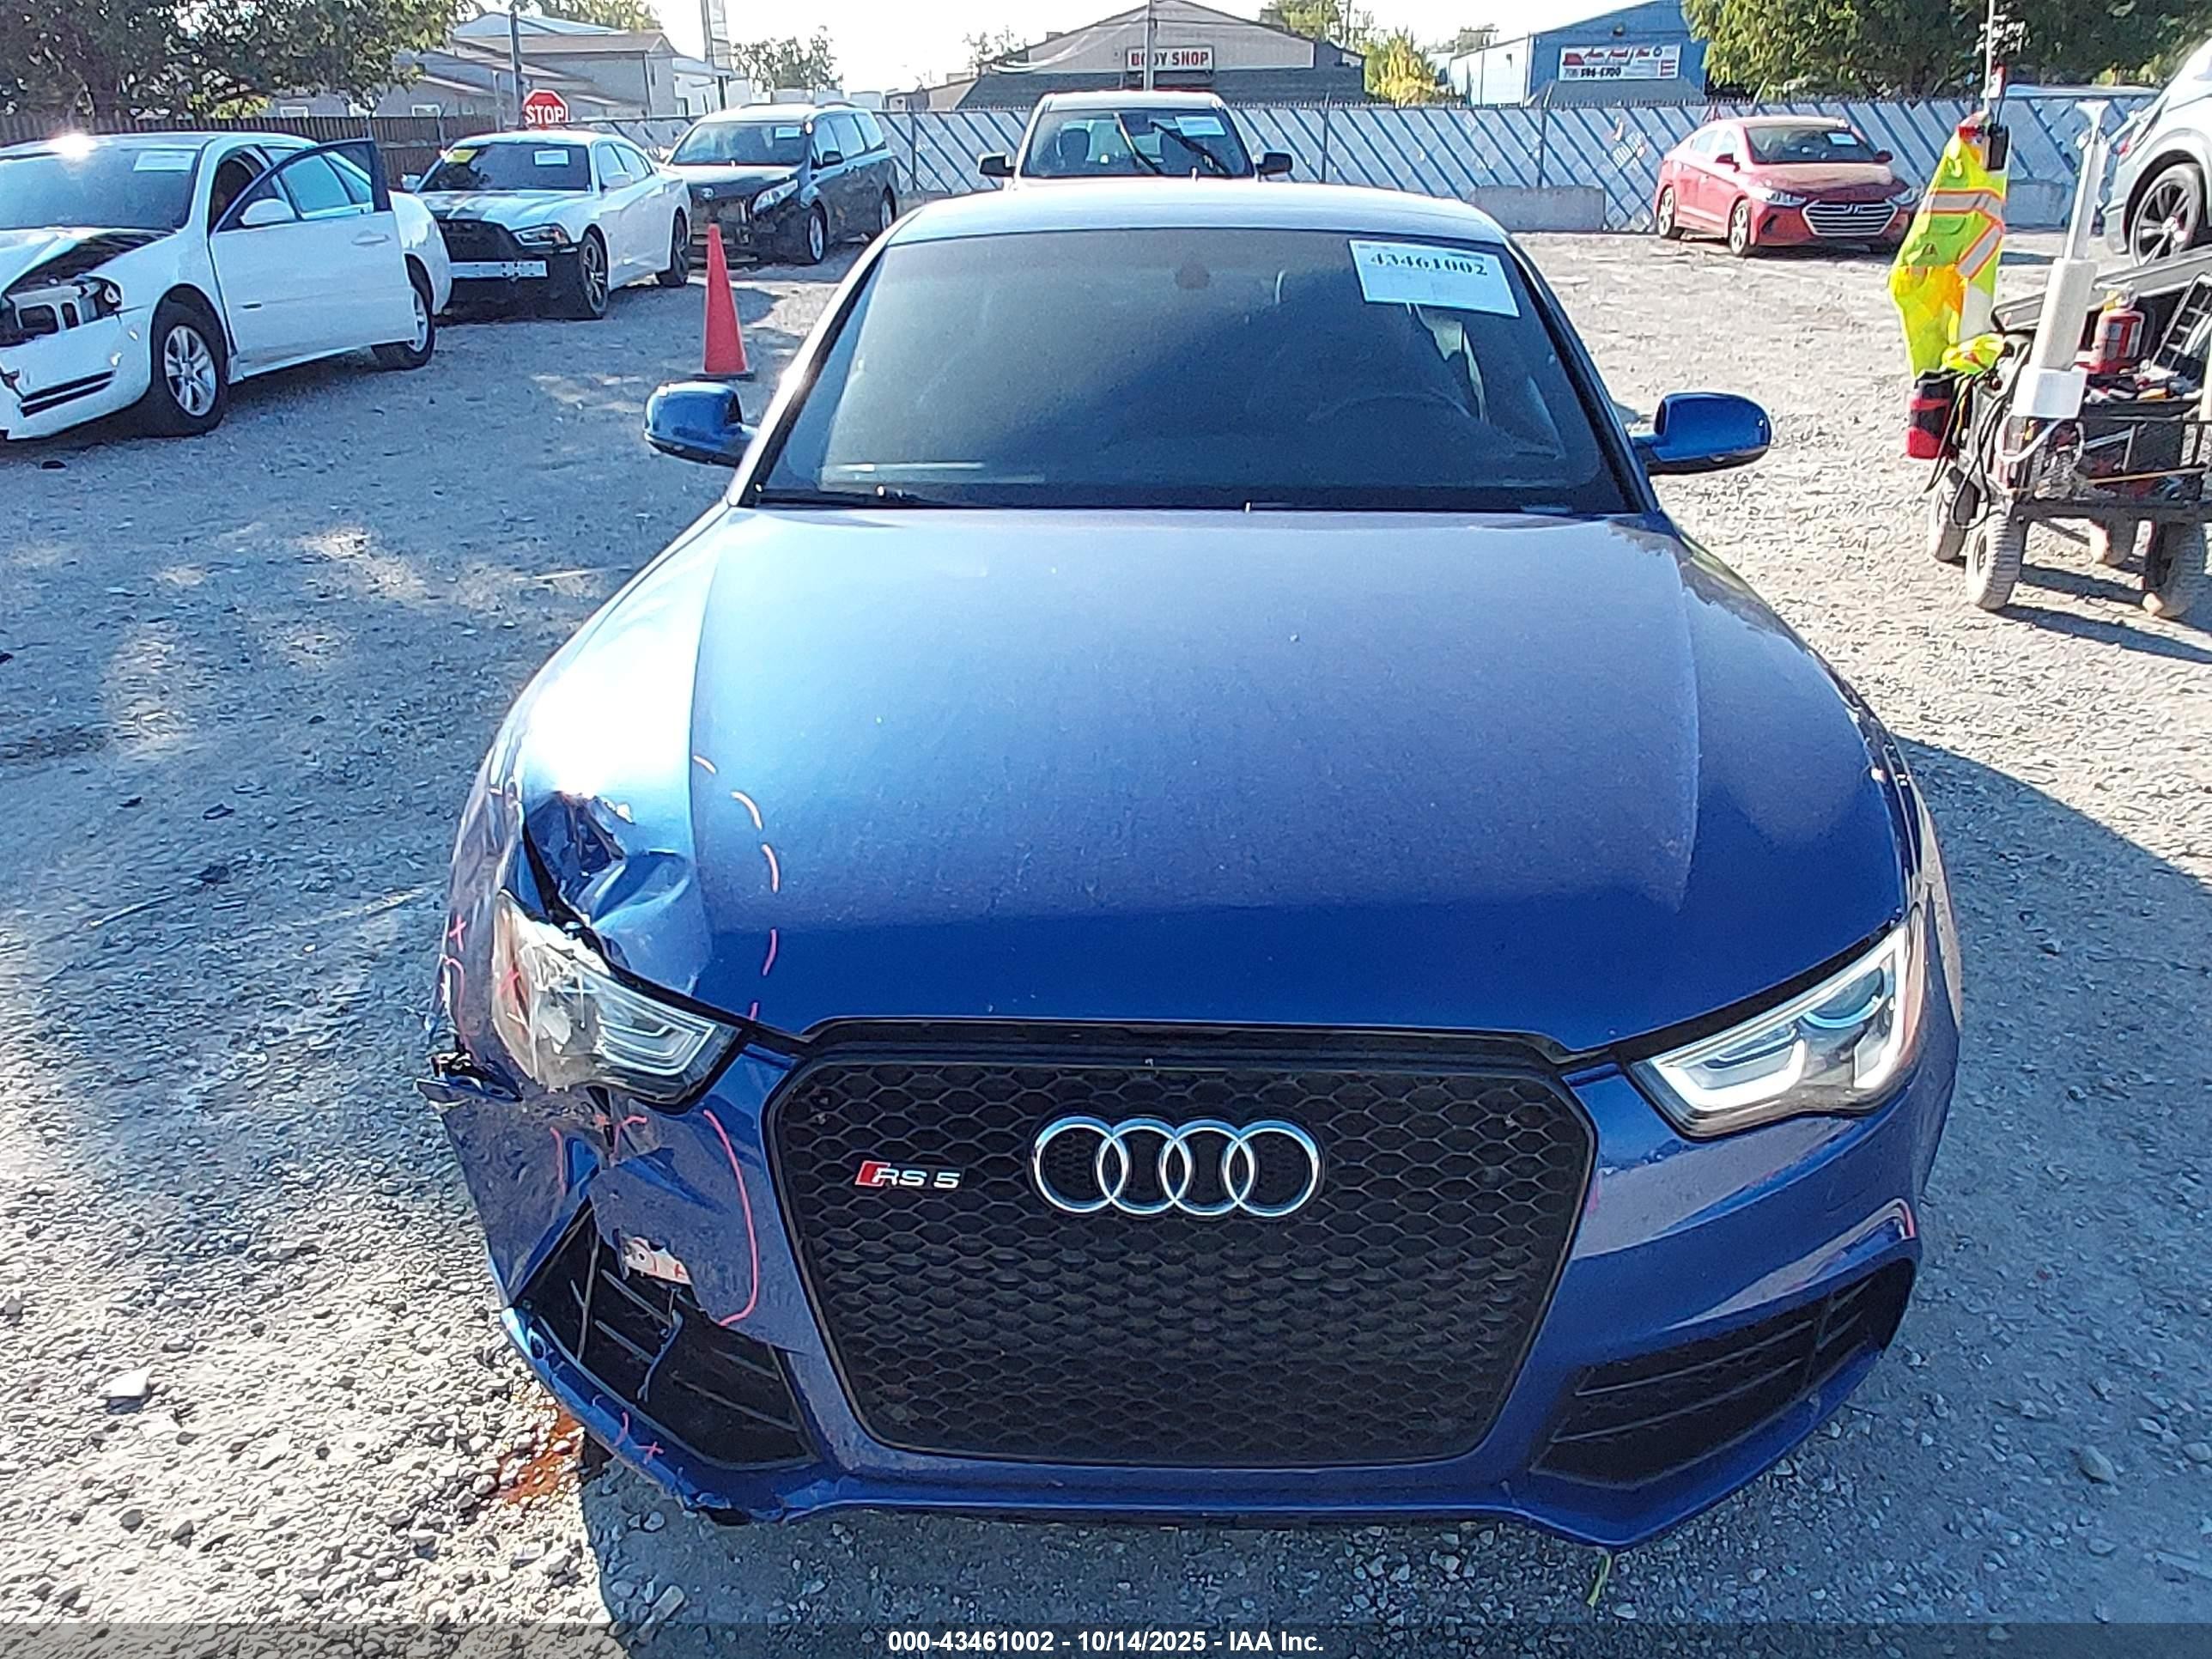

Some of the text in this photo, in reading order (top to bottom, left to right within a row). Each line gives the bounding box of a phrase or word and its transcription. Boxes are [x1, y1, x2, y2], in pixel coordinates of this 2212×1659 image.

[1172, 51, 1209, 66] SHOP
[525, 104, 564, 125] STOP
[1370, 252, 1488, 276] 43461002
